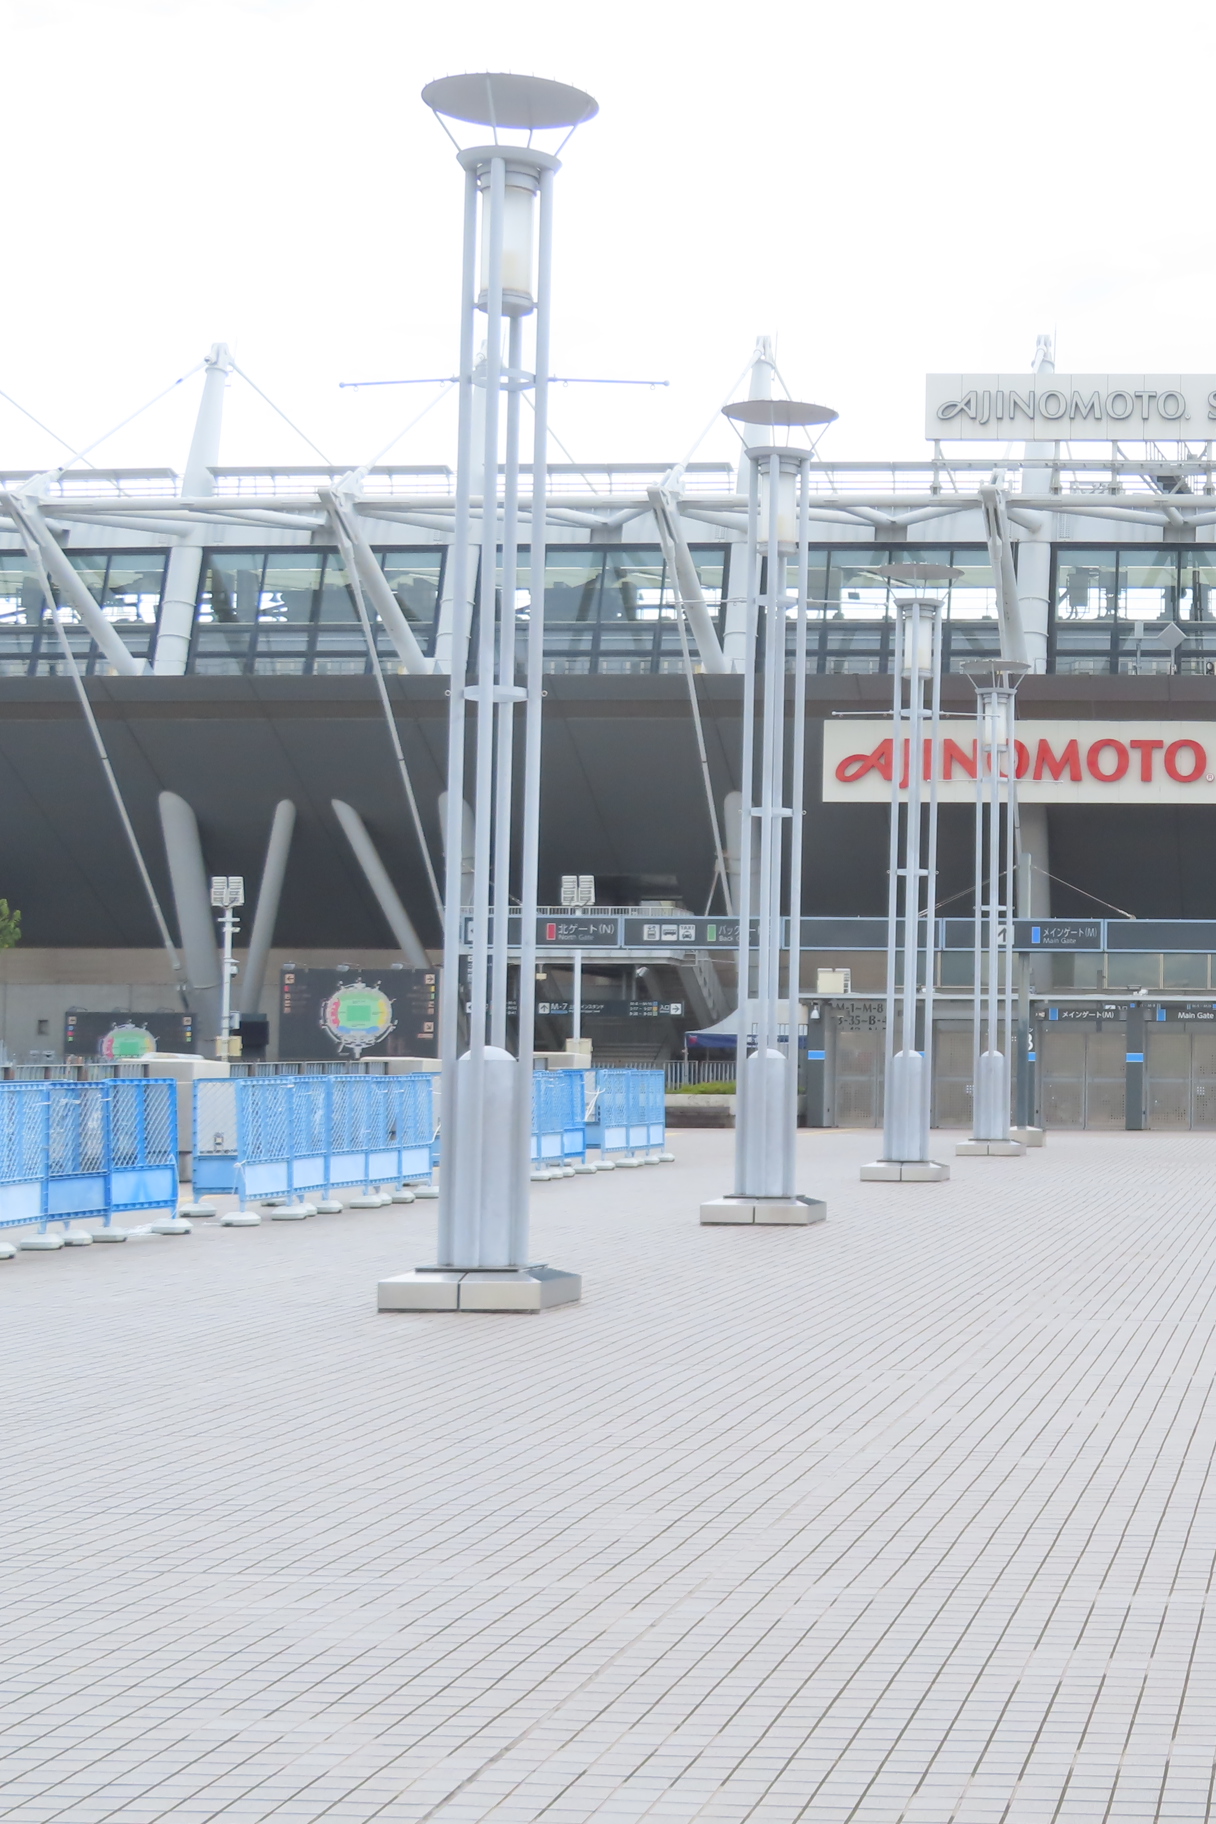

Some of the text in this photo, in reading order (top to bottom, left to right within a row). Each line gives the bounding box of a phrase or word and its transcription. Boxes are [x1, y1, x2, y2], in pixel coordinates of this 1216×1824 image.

[1043, 927, 1097, 938] メインゲート(M)
[1062, 1011, 1114, 1019] メインゲート(M)
[1178, 1011, 1215, 1019] Main Gate
